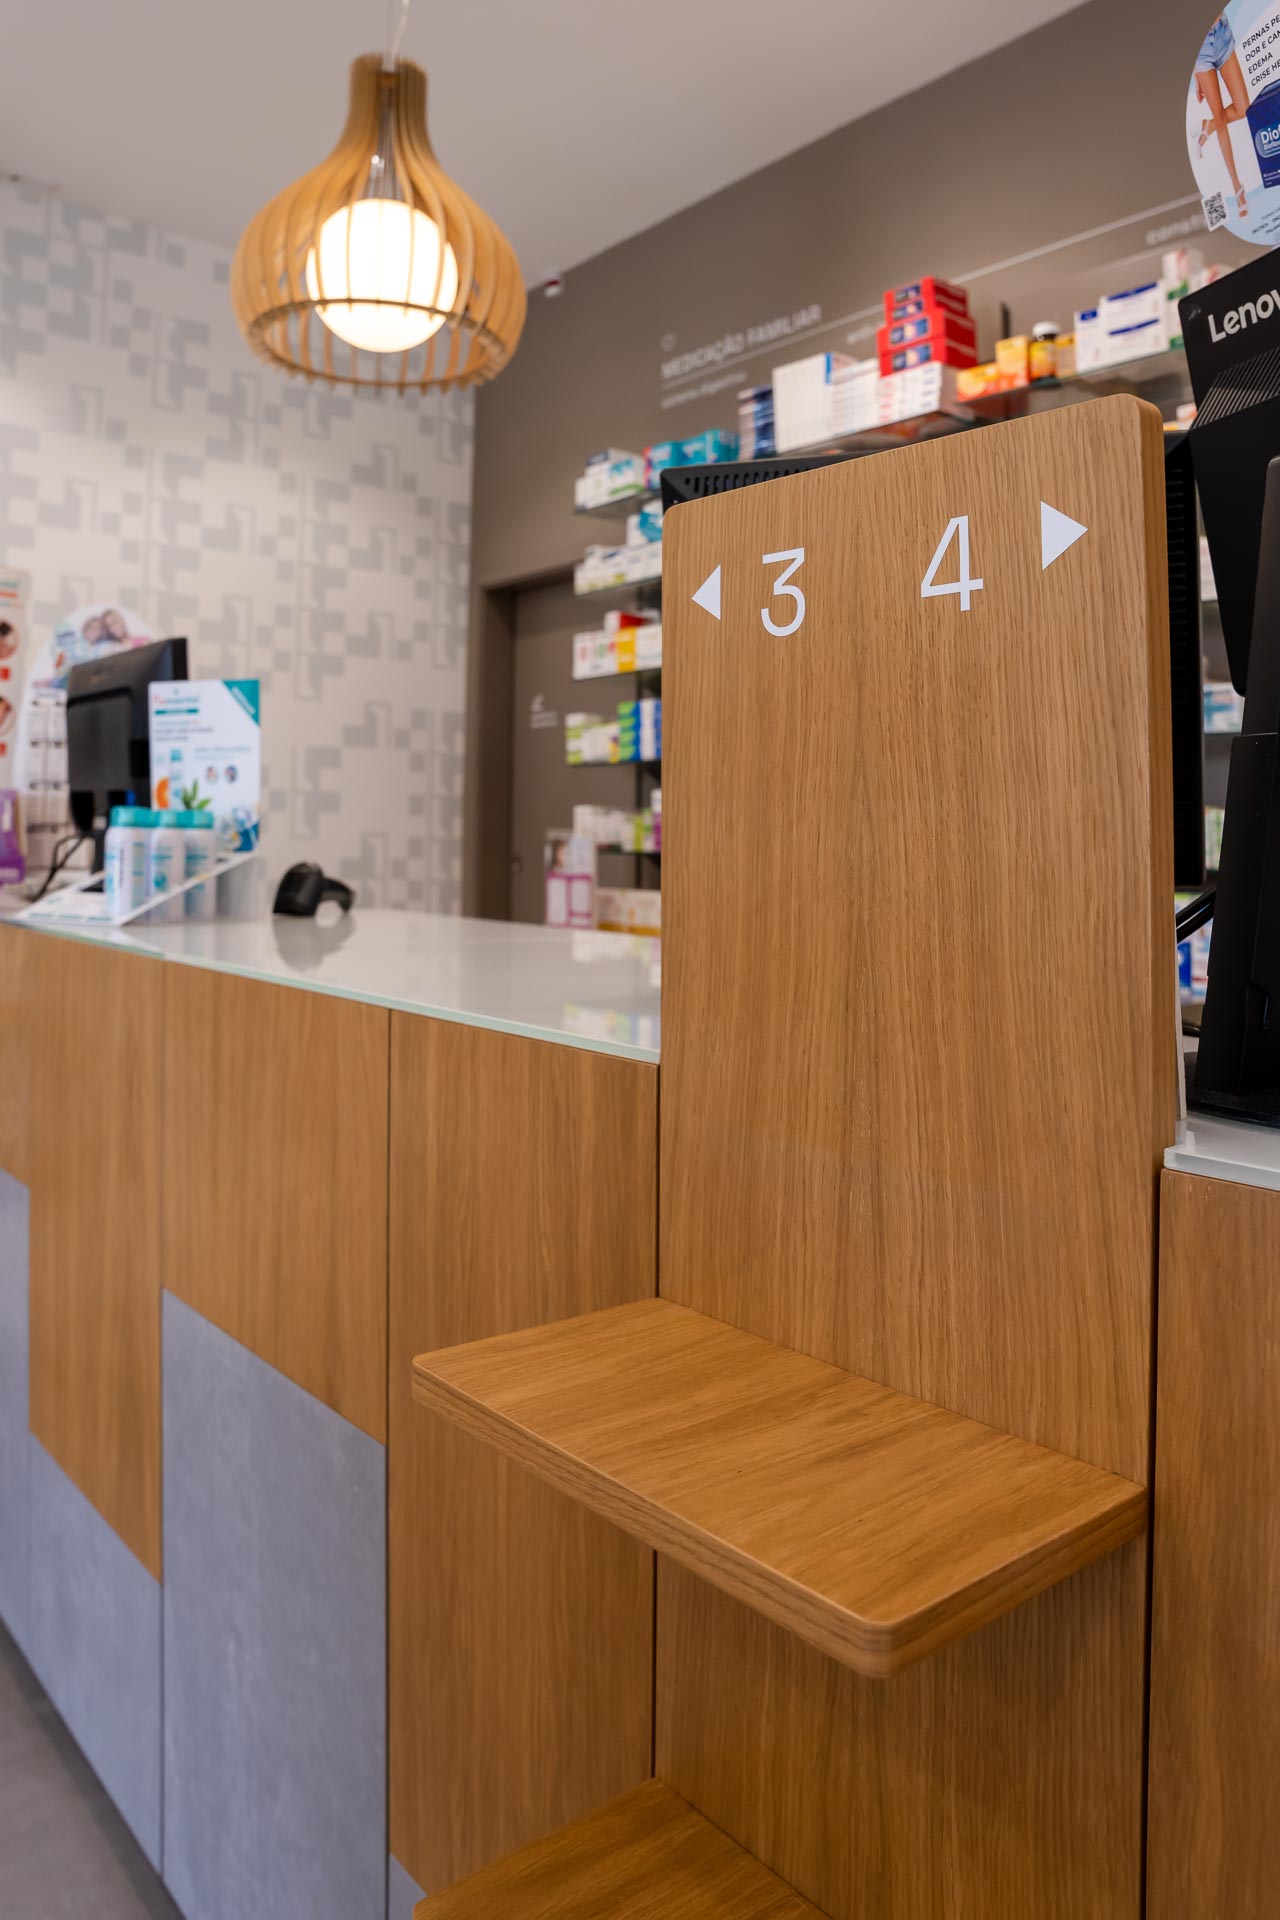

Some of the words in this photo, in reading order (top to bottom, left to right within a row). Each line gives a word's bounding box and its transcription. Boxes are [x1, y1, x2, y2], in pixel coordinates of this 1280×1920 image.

[1242, 23, 1270, 50] PERNAS
[1245, 46, 1261, 62] DOR
[1261, 41, 1267, 50] E
[1248, 52, 1273, 74] EDEMA
[1250, 67, 1271, 86] CRISE
[1261, 124, 1280, 144] Dio
[746, 303, 822, 347] FAMILIAR
[761, 547, 806, 636] 3
[920, 515, 983, 612] 4
